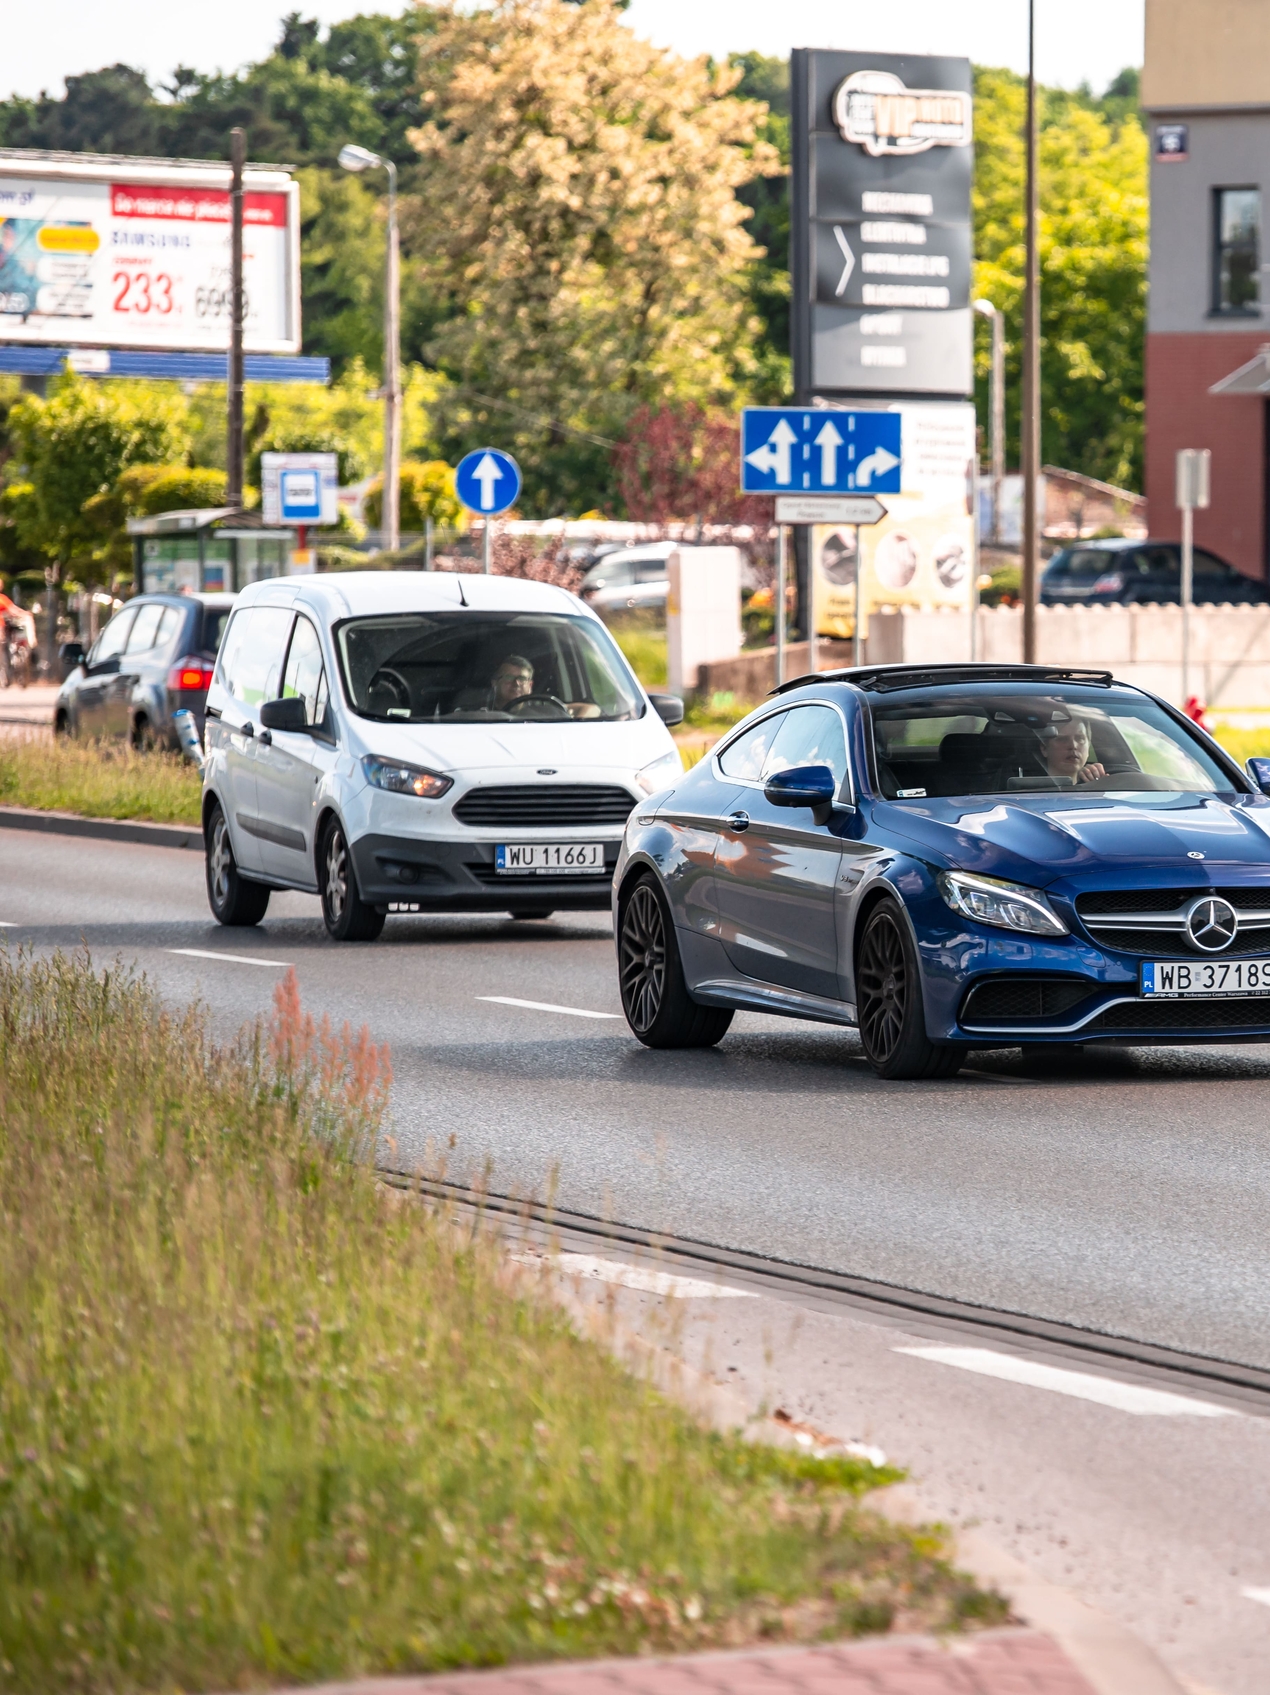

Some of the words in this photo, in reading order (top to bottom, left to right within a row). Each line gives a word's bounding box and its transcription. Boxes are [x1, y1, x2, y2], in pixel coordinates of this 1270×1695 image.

[113, 271, 173, 313] 233
[509, 847, 534, 866] WU
[542, 846, 597, 866] 1166J
[1160, 965, 1192, 990] WB
